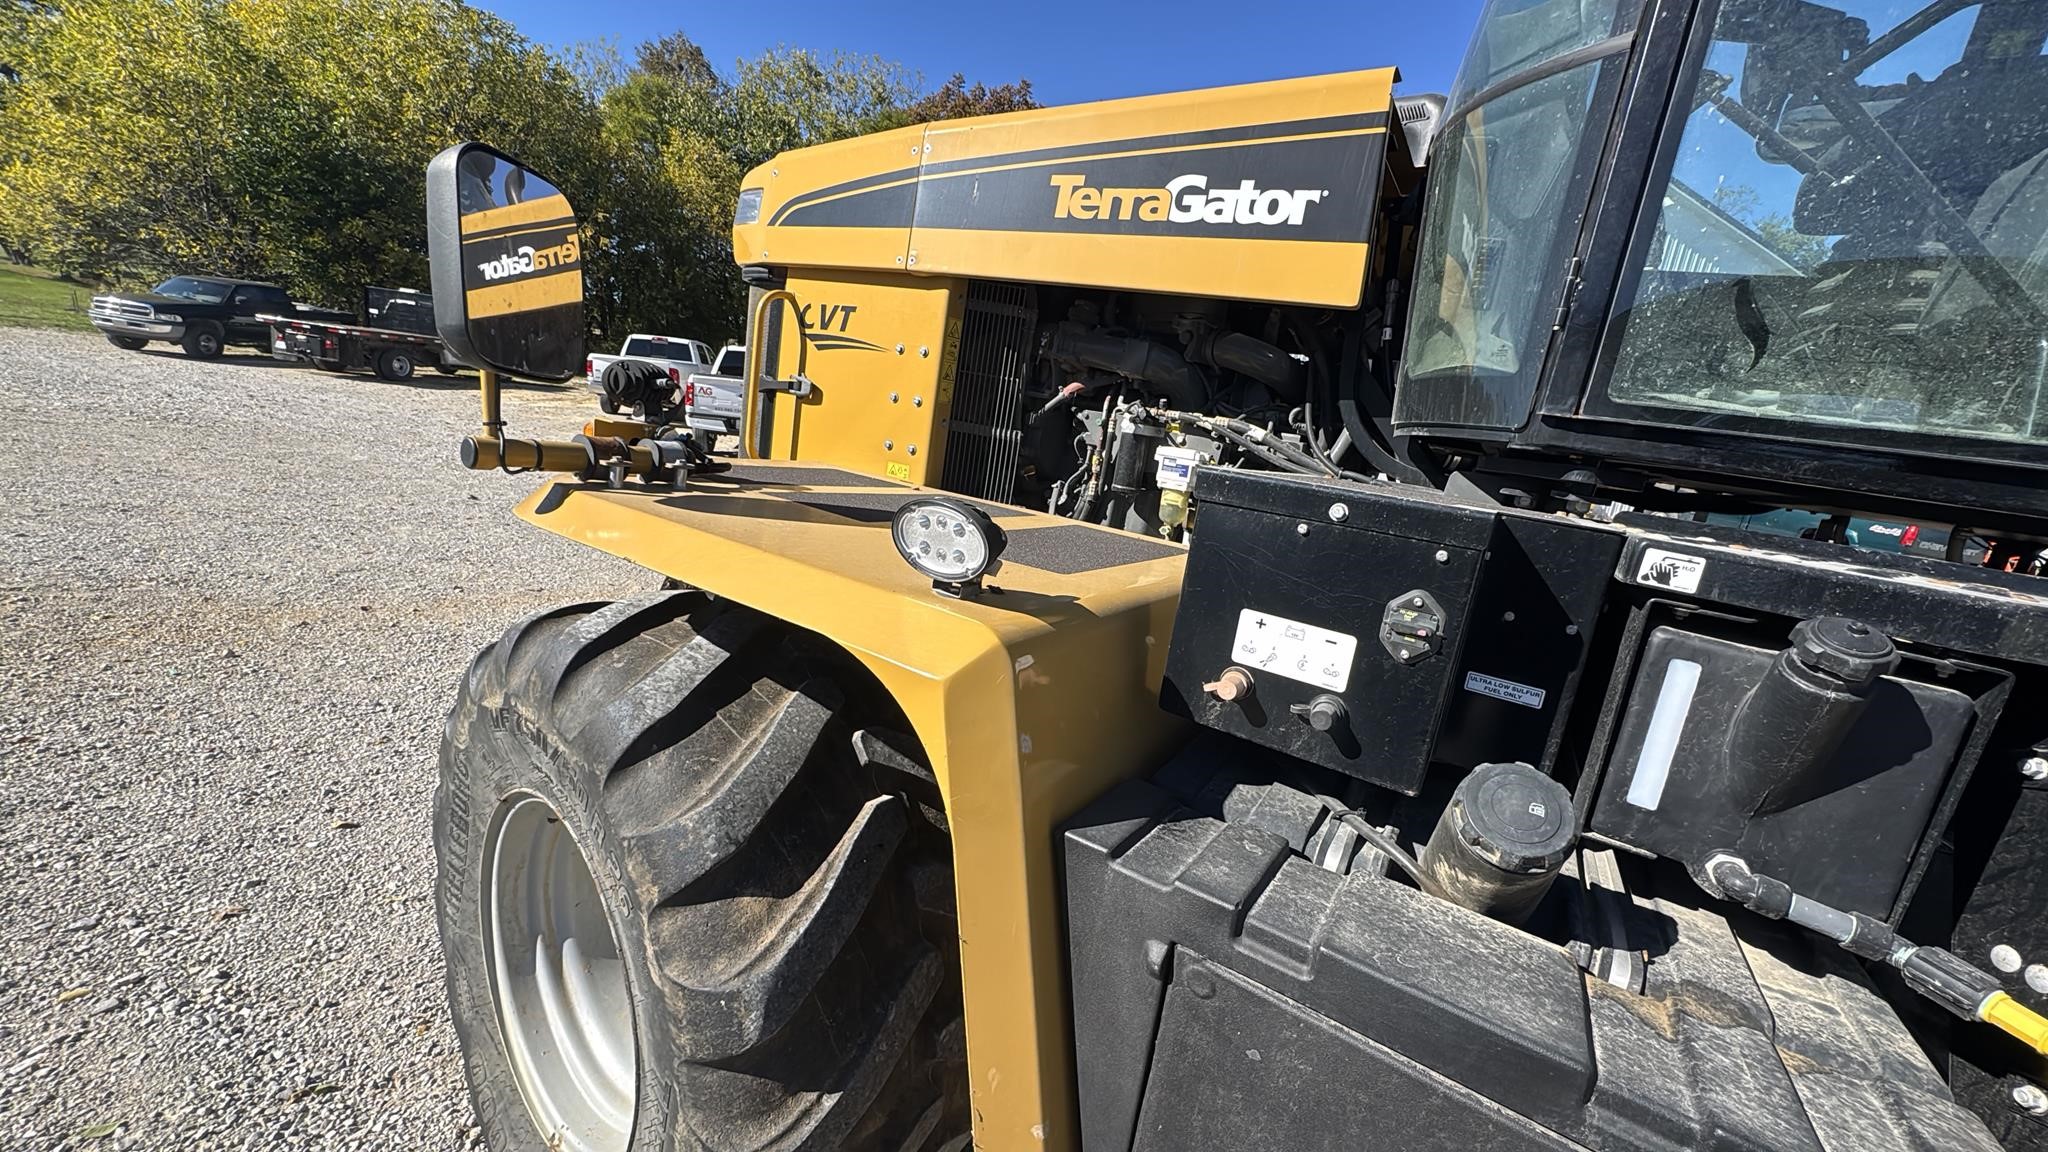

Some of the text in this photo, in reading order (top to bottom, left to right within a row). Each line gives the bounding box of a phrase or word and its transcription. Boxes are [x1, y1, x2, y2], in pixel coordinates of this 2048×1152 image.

[1050, 174, 1329, 225] TerraGator
[800, 303, 857, 332] CVT
[697, 386, 713, 396] AG
[1470, 675, 1540, 698] ULTRA LOW SULFUR
[1483, 686, 1523, 700] FUEL ONLY
